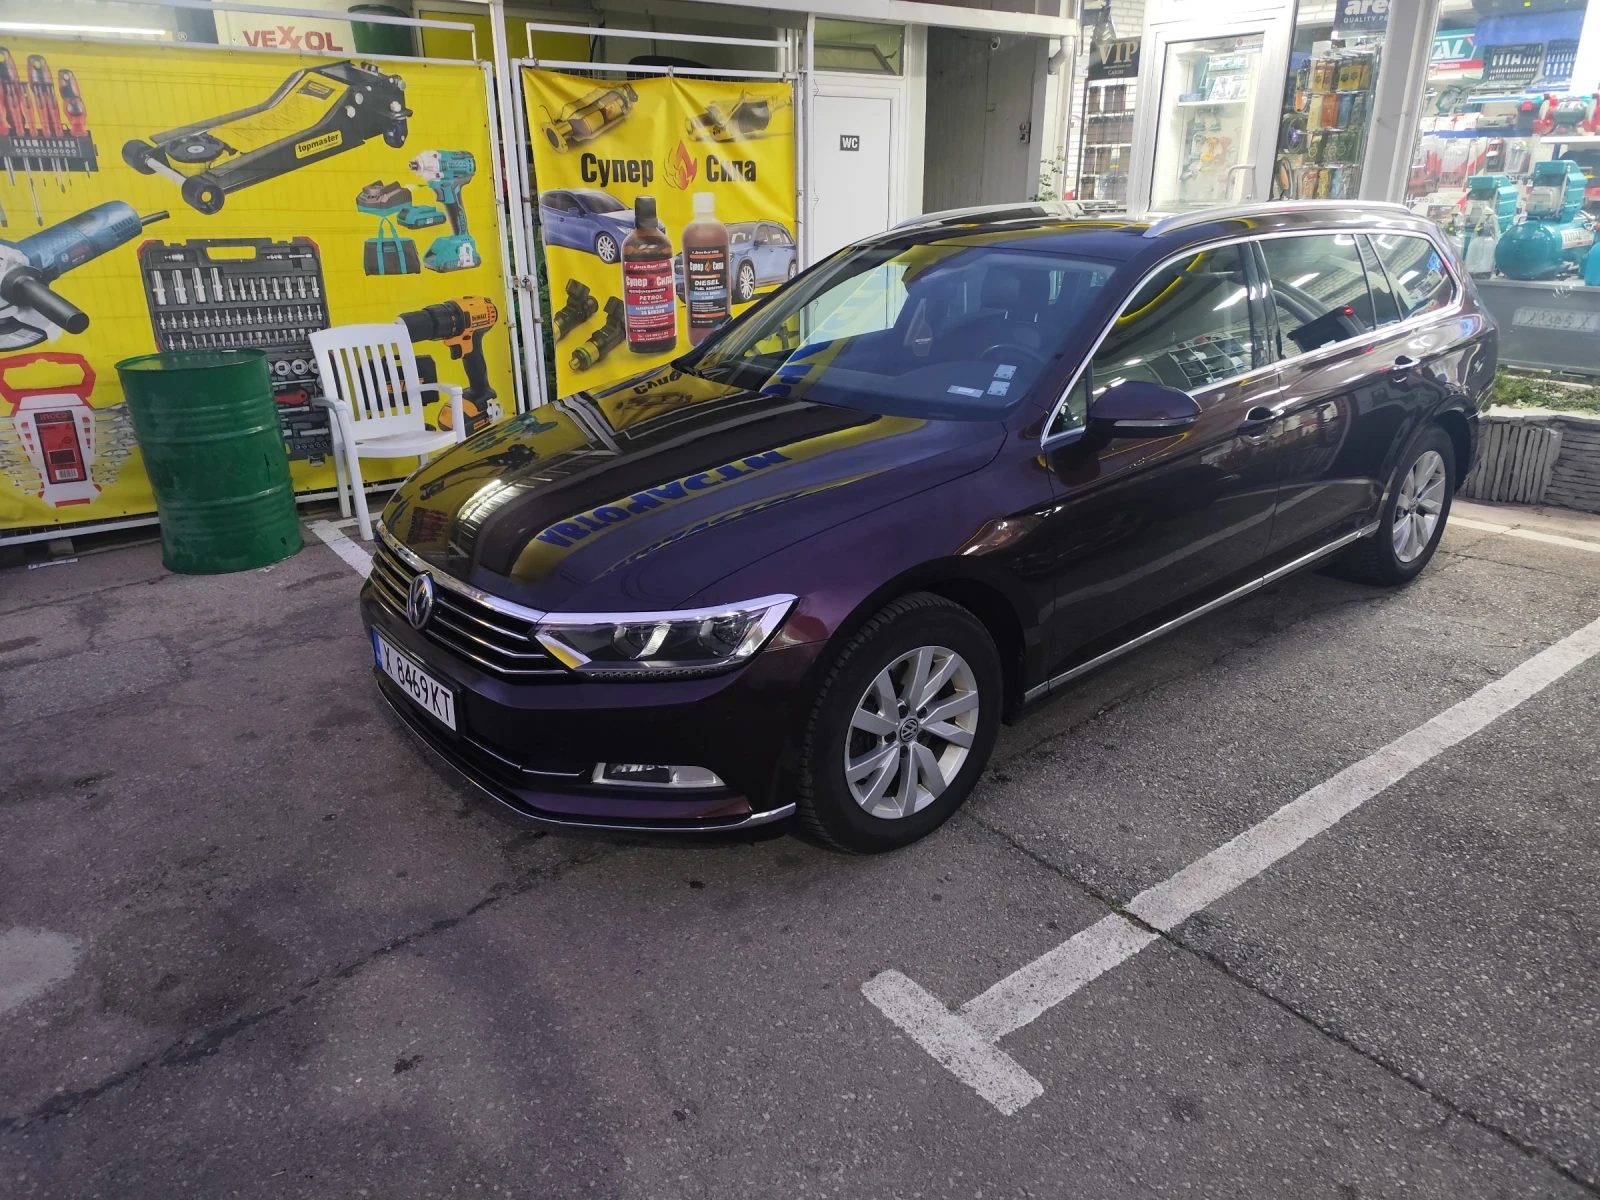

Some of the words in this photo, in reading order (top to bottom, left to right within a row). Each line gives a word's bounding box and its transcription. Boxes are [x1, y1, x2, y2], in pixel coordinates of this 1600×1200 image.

[1097, 41, 1139, 65] VIP
[298, 133, 340, 153] topmaster
[842, 137, 858, 149] WC
[580, 152, 654, 188] Супер
[706, 154, 757, 183] Сила
[625, 275, 648, 288] Супер
[694, 279, 720, 287] DIESEL
[396, 656, 451, 722] 8469KT
